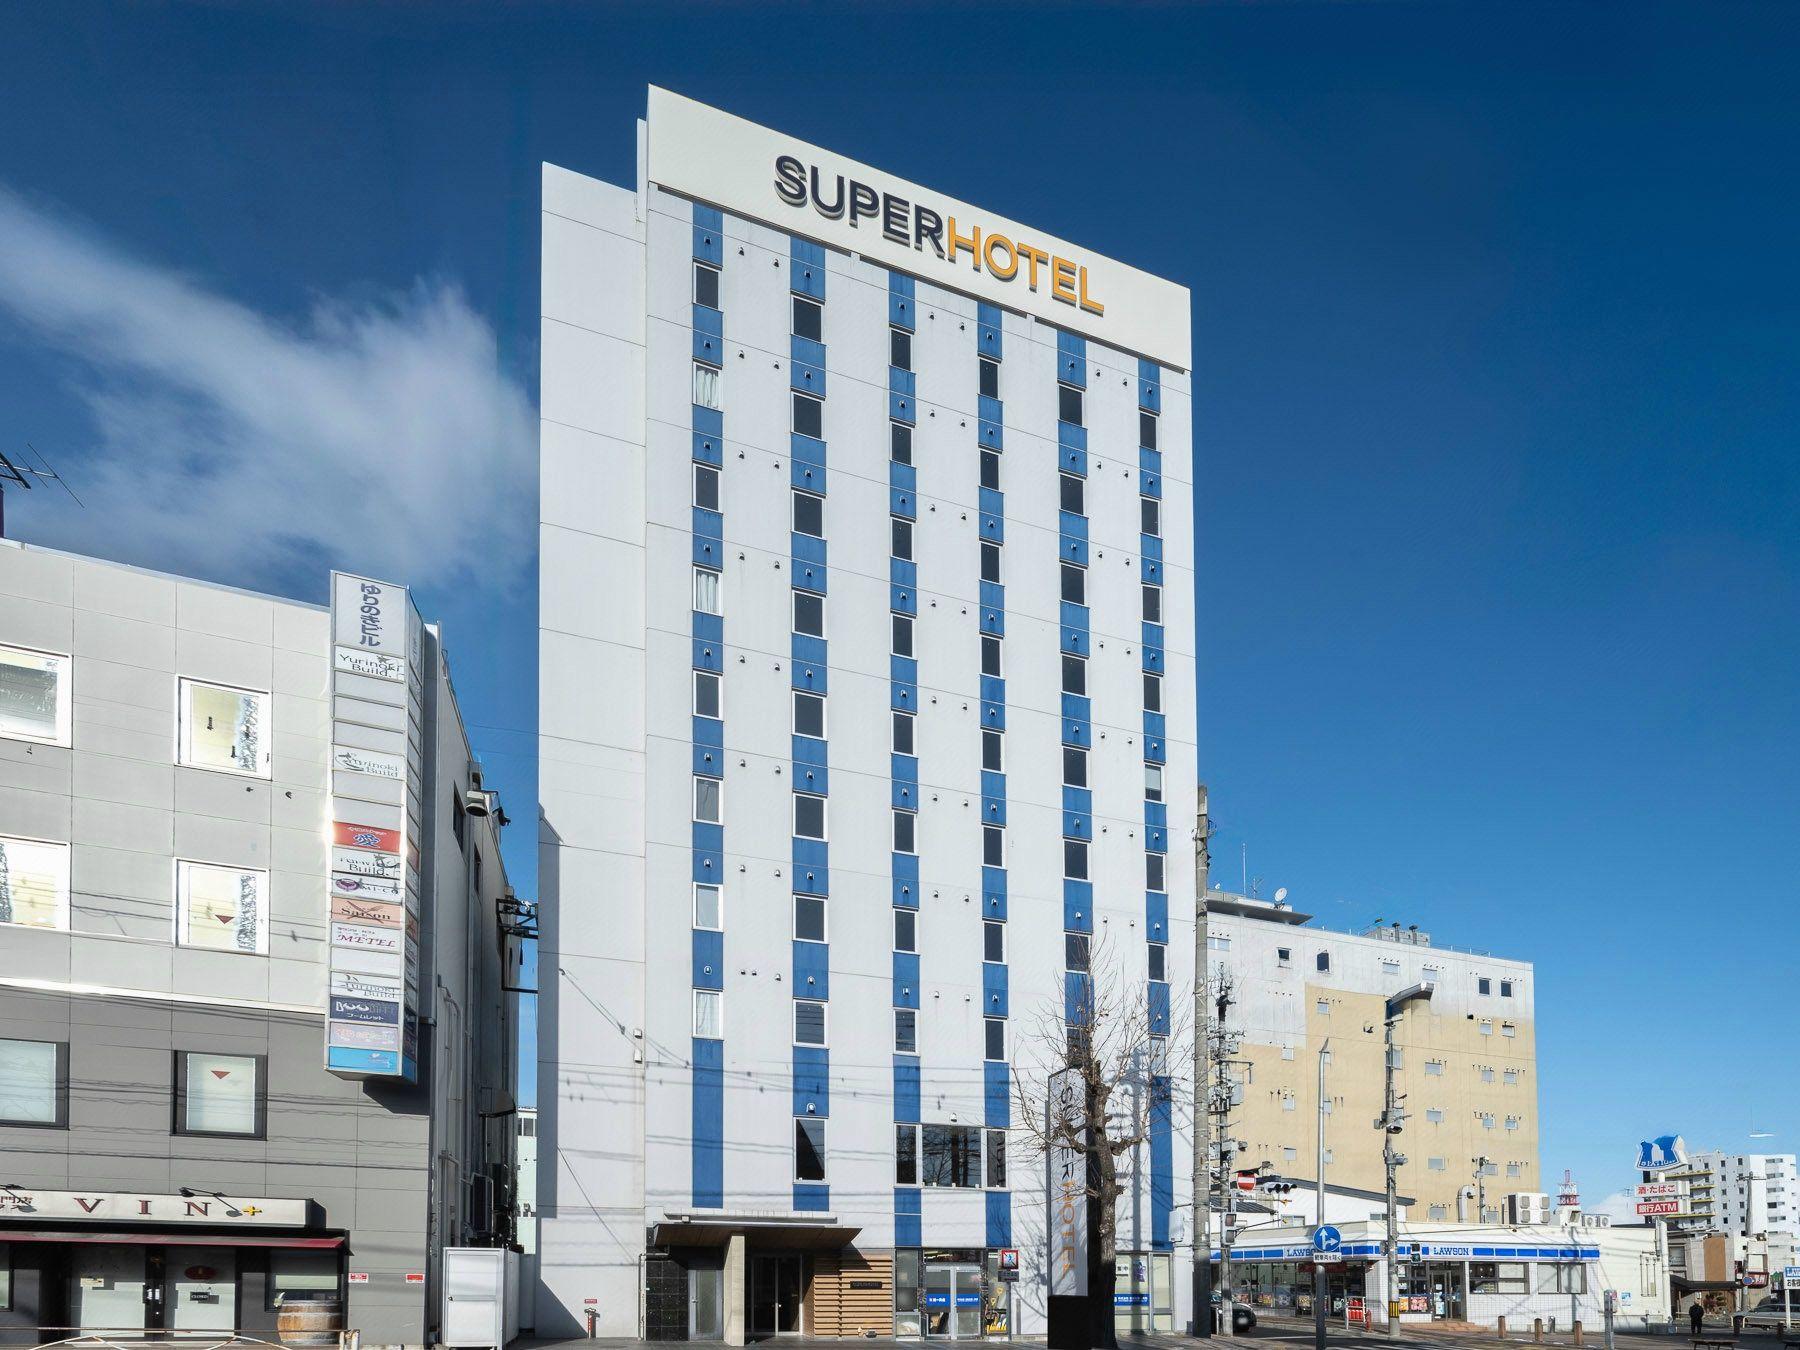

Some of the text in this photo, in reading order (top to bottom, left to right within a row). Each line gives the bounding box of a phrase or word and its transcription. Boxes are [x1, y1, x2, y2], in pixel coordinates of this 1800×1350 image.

[1060, 1086, 1077, 1279] SUERHOTEL
[1286, 1248, 1315, 1257] LAWSO
[1433, 1247, 1470, 1256] LAWSON
